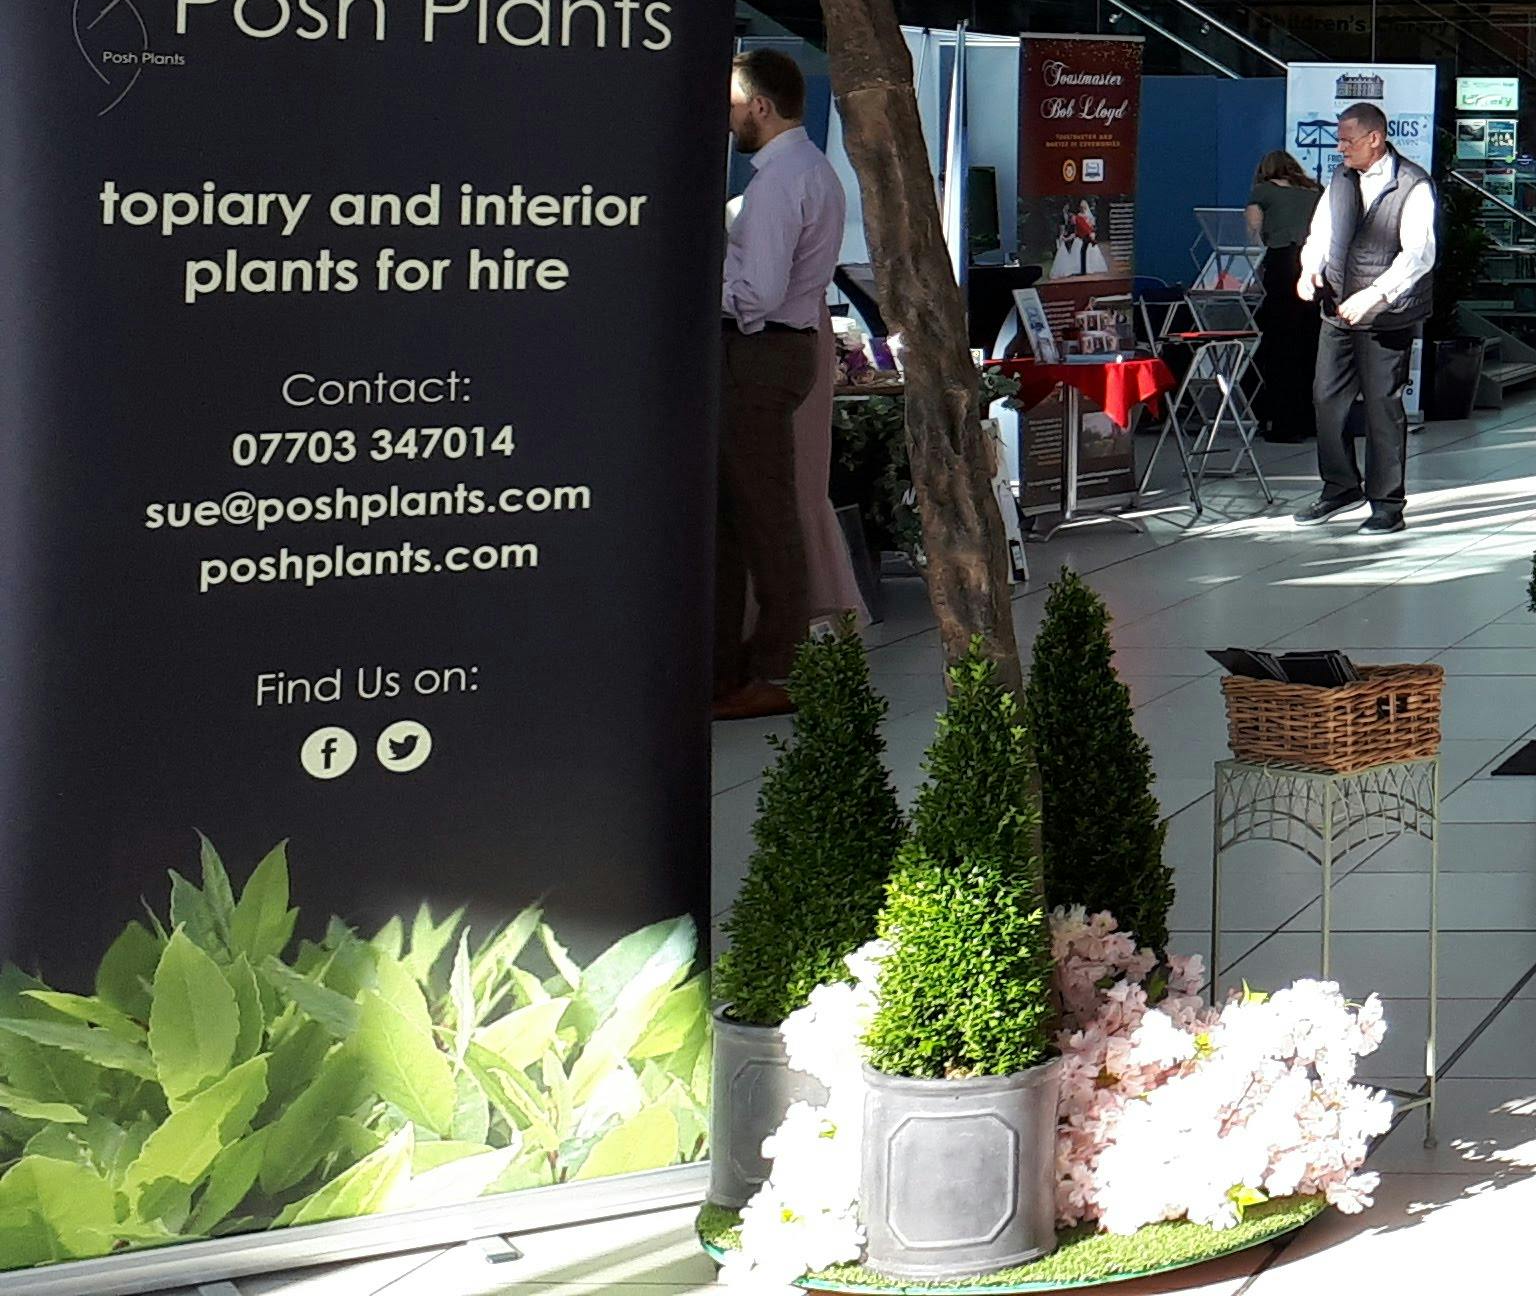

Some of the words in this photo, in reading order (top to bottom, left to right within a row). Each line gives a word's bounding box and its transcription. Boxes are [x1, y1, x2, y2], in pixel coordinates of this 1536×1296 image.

[102, 50, 137, 65] Posh
[141, 51, 185, 66] Plants
[1042, 59, 1125, 87] Toastmaster
[1041, 96, 1076, 119] Bob
[1079, 94, 1128, 126] Lloyd
[1387, 120, 1419, 137] SICS
[100, 180, 311, 236] topiary
[330, 183, 440, 227] and
[460, 183, 647, 228] interior
[185, 248, 358, 304] plants
[376, 247, 450, 291] for
[468, 248, 570, 291] hire
[282, 370, 471, 408] Contact:
[232, 431, 357, 467] 07703
[370, 425, 515, 462] 347014
[145, 482, 591, 531] sue@poshplants.com
[199, 542, 538, 592] poshplants.com
[256, 668, 342, 707] Find
[357, 665, 401, 699] Us
[414, 664, 479, 696] on:
